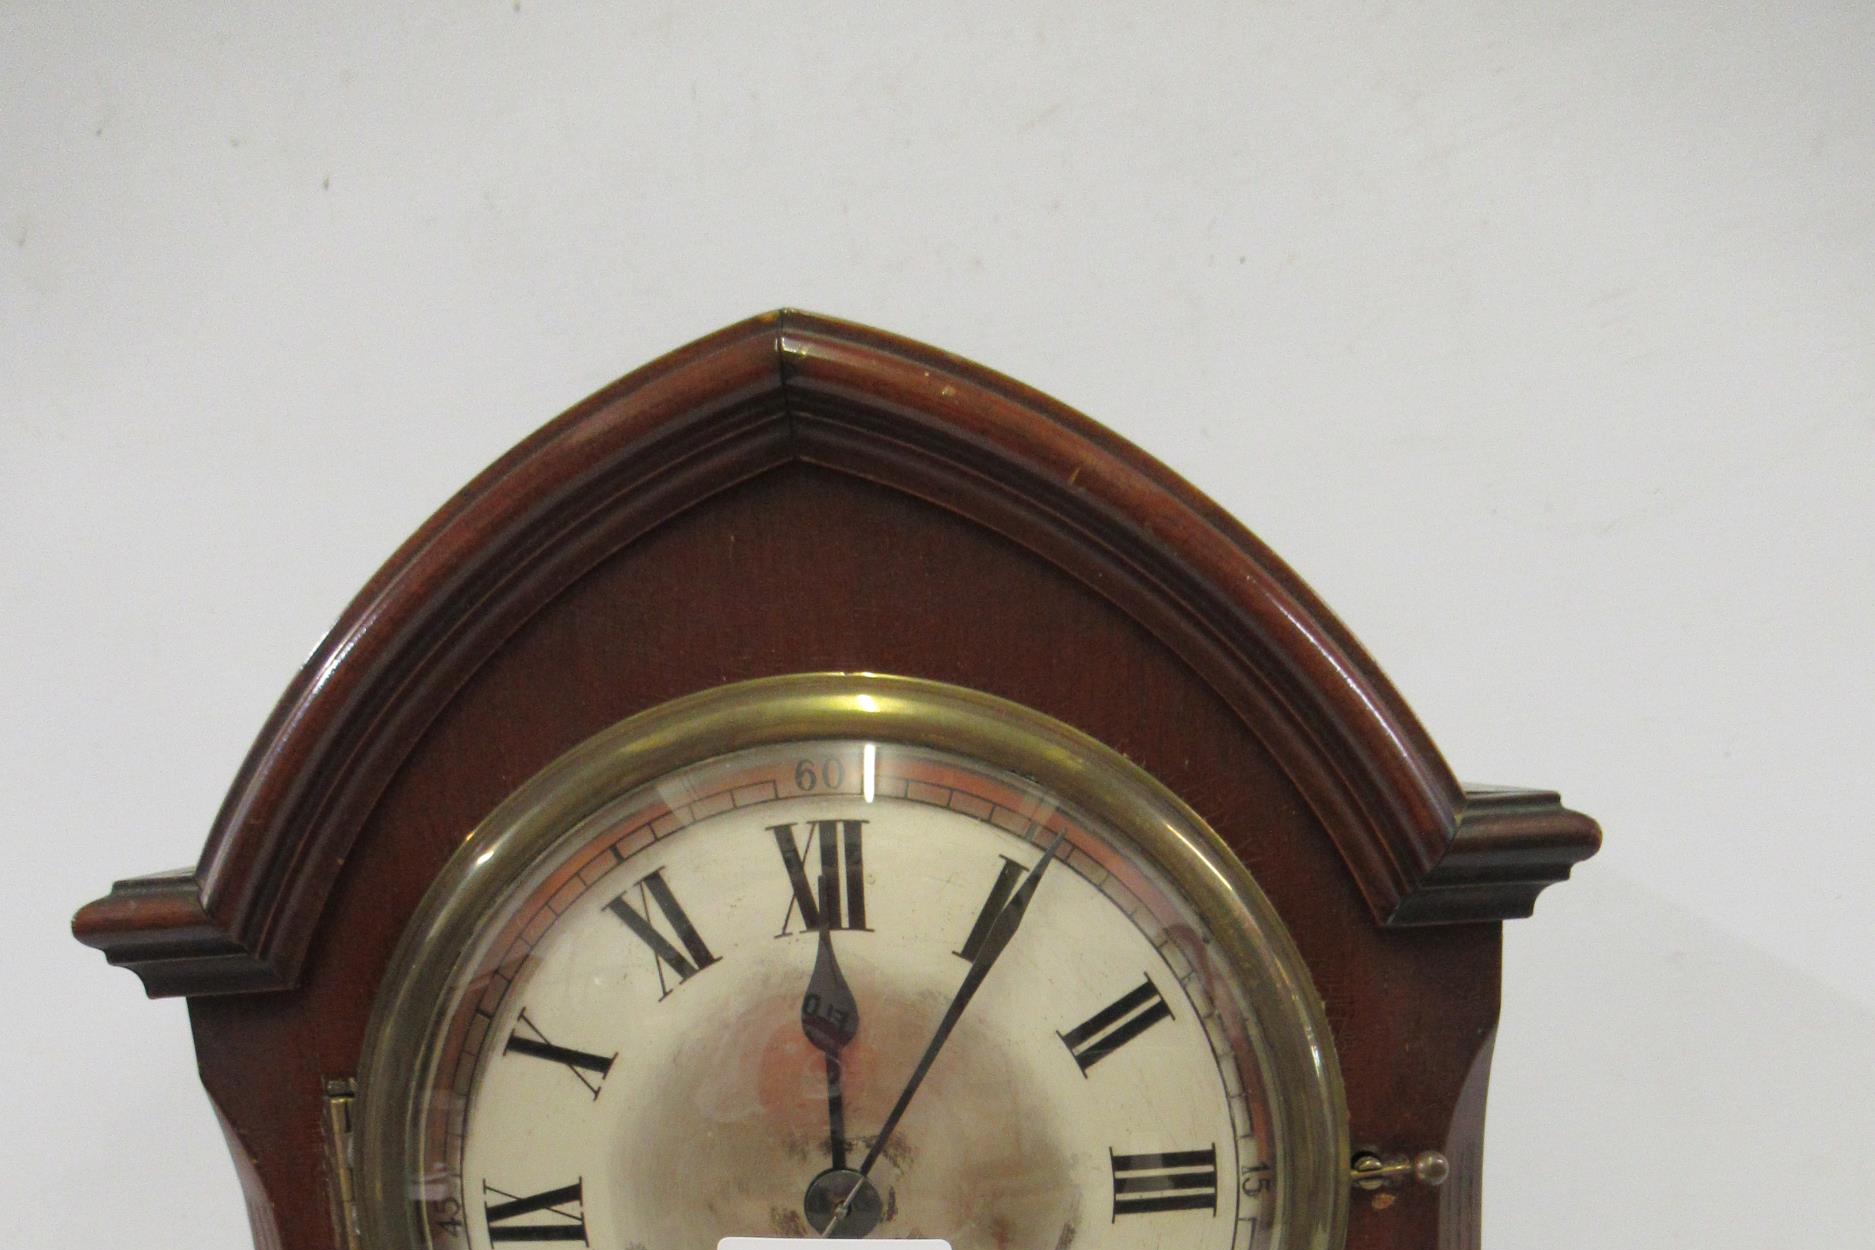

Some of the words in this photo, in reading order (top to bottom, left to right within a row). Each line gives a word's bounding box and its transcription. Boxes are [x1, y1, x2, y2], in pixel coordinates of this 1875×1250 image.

[794, 758, 846, 792] 60
[766, 819, 874, 938] XII
[952, 854, 1030, 963] I
[602, 865, 723, 1002] XI
[503, 1007, 619, 1101] X
[1056, 972, 1175, 1079] II
[483, 1176, 589, 1249] IX
[1109, 1143, 1217, 1224] III
[1242, 1160, 1272, 1197] 15
